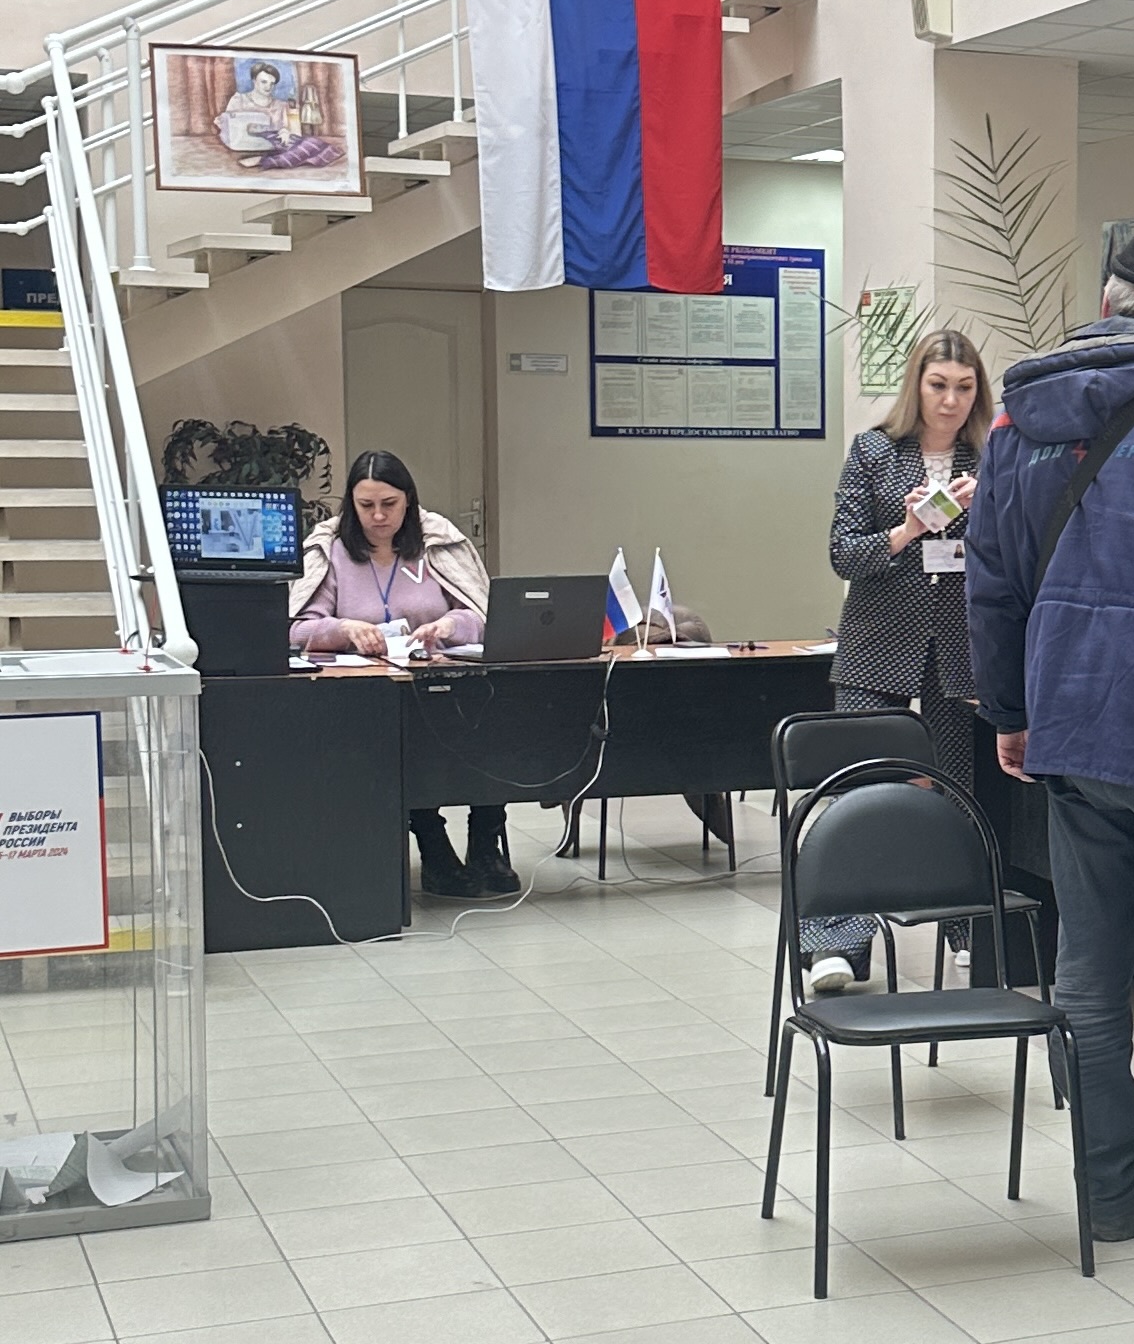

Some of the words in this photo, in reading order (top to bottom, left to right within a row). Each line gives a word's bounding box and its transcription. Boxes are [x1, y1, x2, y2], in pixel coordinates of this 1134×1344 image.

[8, 809, 63, 823] ВЫБОРЫ
[3, 821, 78, 836] ПРЕЗИДЕНТА
[17, 848, 47, 859] МАРТА
